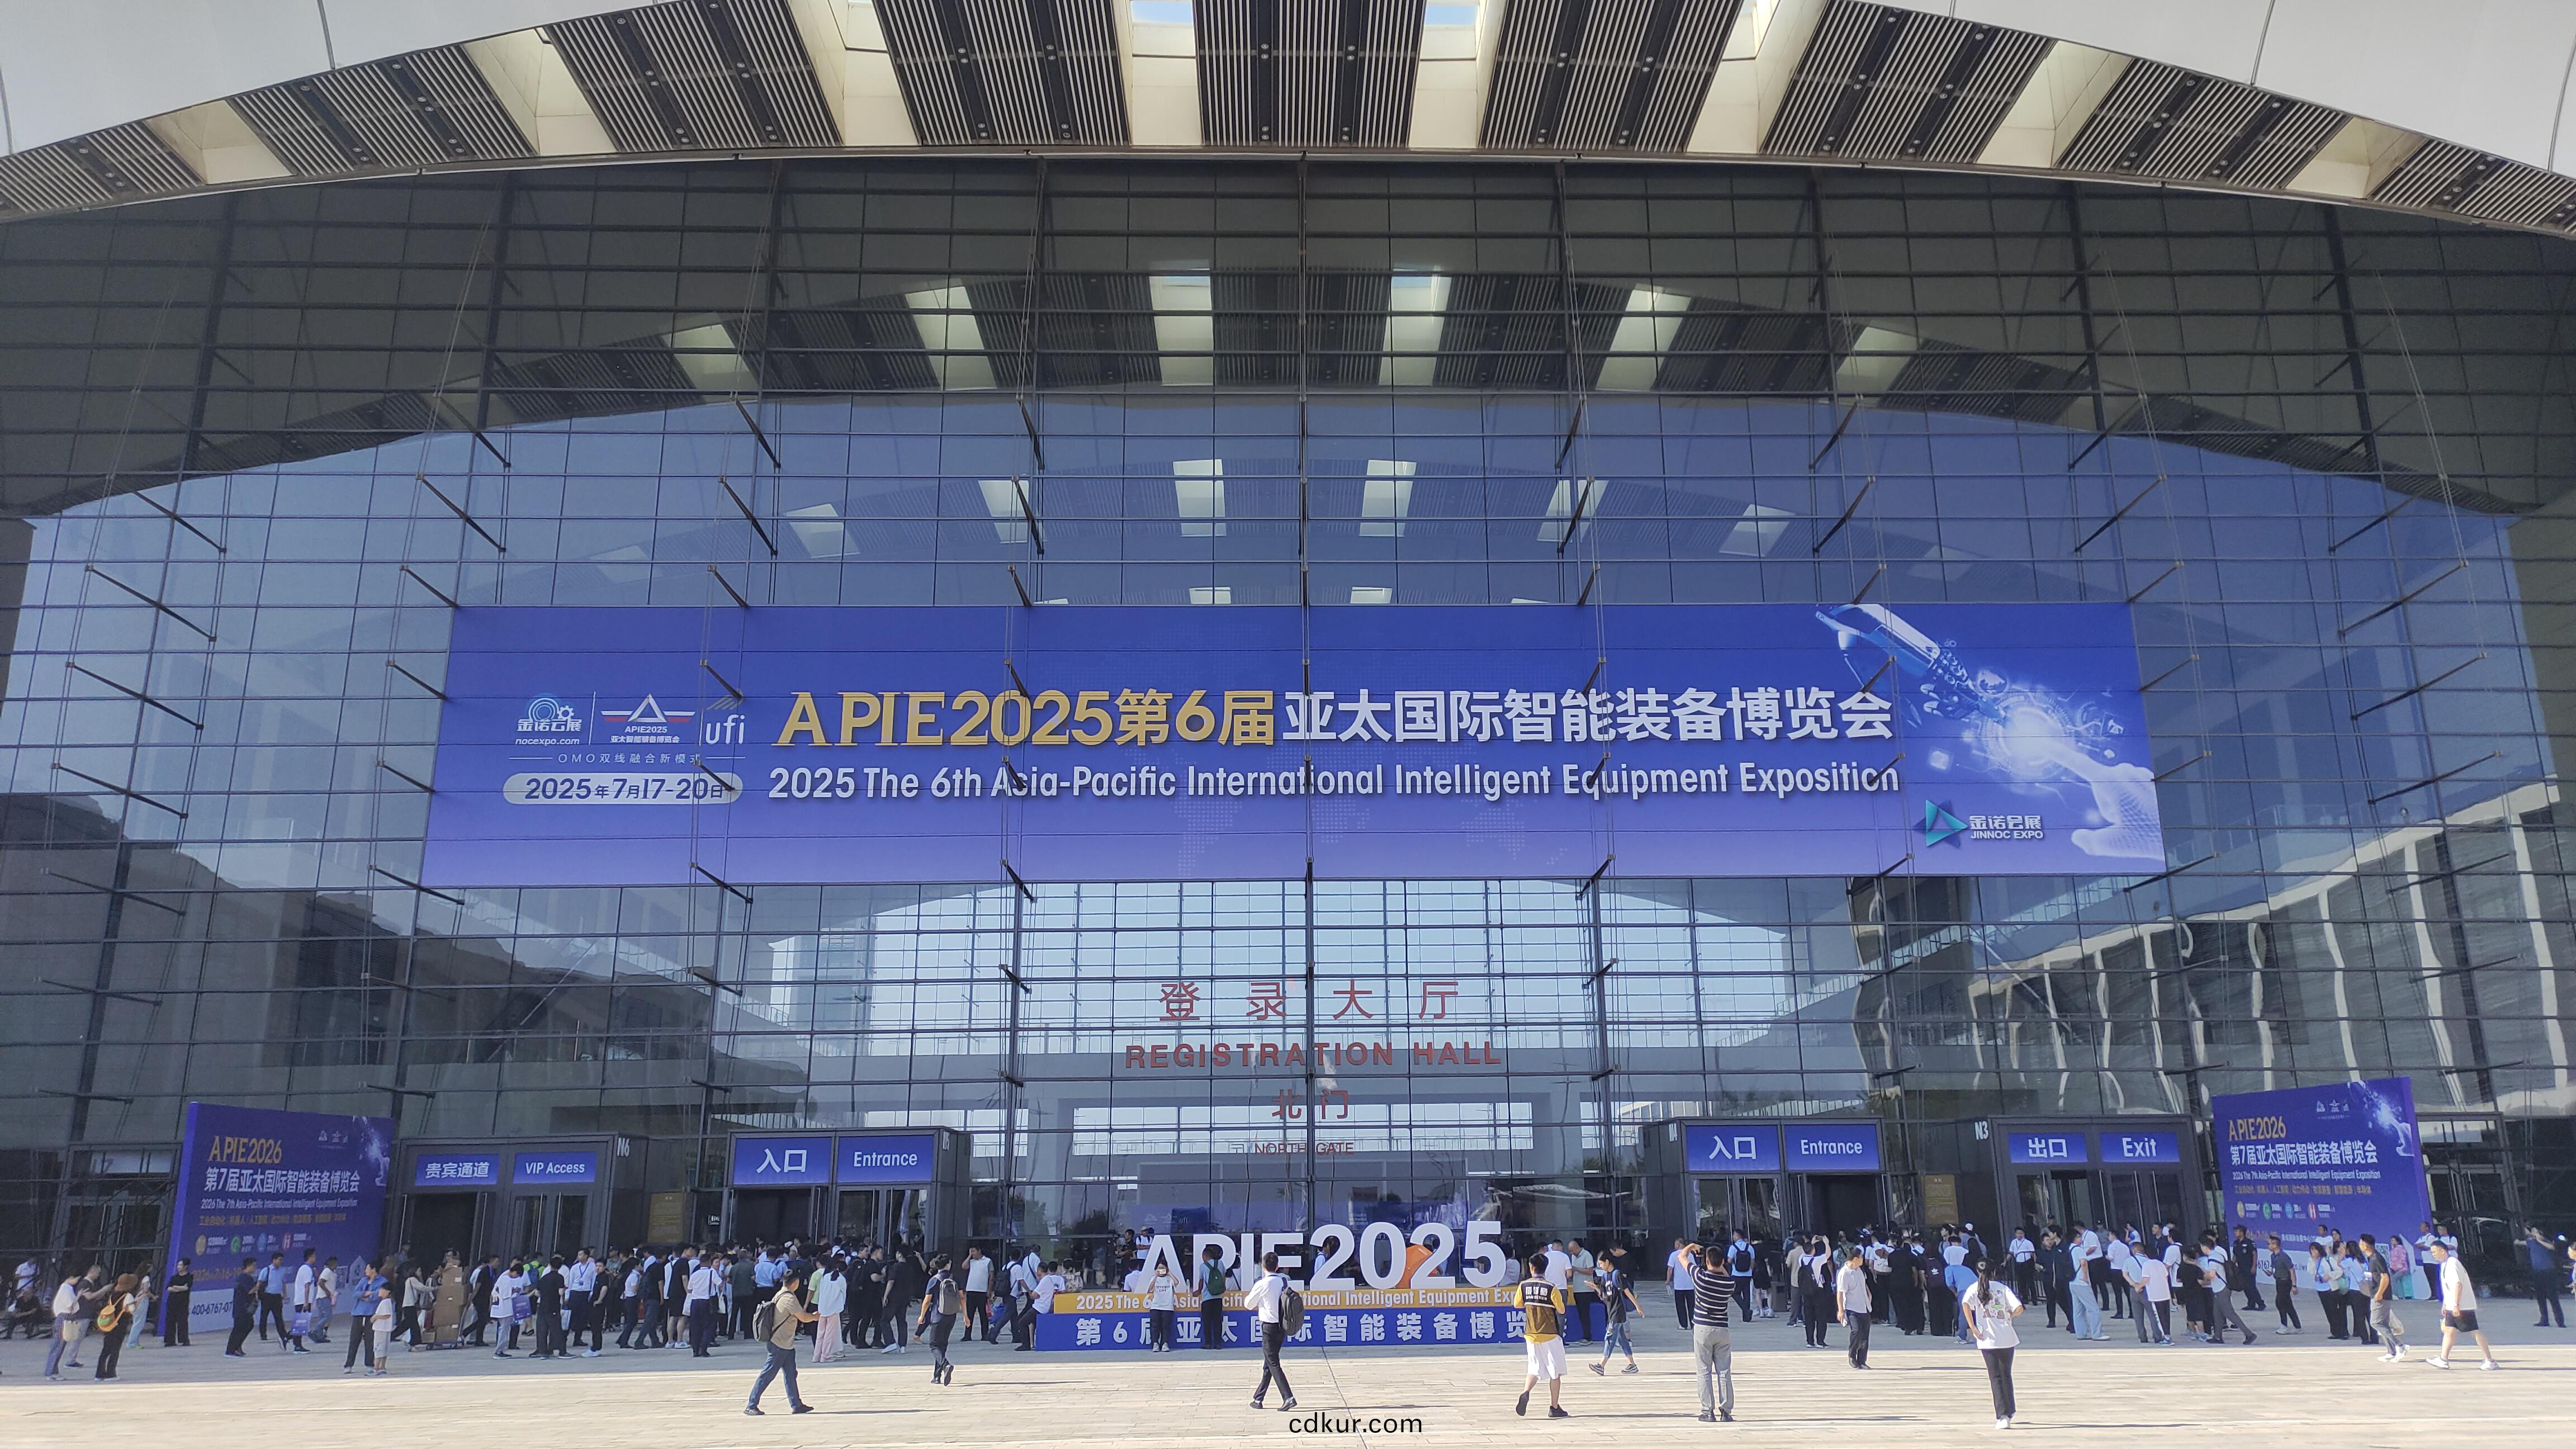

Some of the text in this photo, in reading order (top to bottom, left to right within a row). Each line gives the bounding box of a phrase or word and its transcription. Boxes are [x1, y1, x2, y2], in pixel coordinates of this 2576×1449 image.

[705, 714, 745, 745] ufi
[515, 738, 580, 747] nocexpo.com
[524, 778, 724, 800] 2025年7月17-20日
[769, 761, 1900, 802] 2025 The 6th Asia-Pacific International Intelligent Equipment Exposition
[1971, 830, 2044, 839] JINNOC EXPO
[1158, 978, 1459, 1022] 登录大厅
[1125, 1041, 1502, 1069] REGISTRATION HALL
[1271, 1089, 1348, 1120] 北门
[1974, 1120, 1989, 1140] N3
[2228, 1116, 2286, 1142] APIE2026
[207, 1135, 282, 1164] APIE2026
[617, 1137, 630, 1157] N6
[1254, 1142, 1354, 1156] NORTH GATE
[1708, 1135, 1756, 1160] 入口
[1801, 1139, 1863, 1156] Entrance
[2028, 1138, 2068, 1158] 出口
[2122, 1137, 2157, 1158] Exit
[2231, 1140, 2378, 1166] 第7届亚太国际智能装备博览会
[425, 1161, 490, 1179] 贵宾通道
[525, 1161, 585, 1174] VIP Access
[756, 1148, 807, 1173] 入口
[853, 1151, 918, 1167] Entrance
[204, 1166, 361, 1194] 第7届亚太国际智能装备博览会
[1134, 1220, 1508, 1293] APIE2025
[1077, 1295, 1114, 1310] 2025
[1116, 1295, 1140, 1309] The
[1174, 1292, 1242, 1309] Asiacifi
[1302, 1291, 1341, 1306] tional
[1346, 1290, 1414, 1308] Intelligent
[1419, 1289, 1490, 1306] Equipment
[1494, 1287, 1516, 1305] Exp
